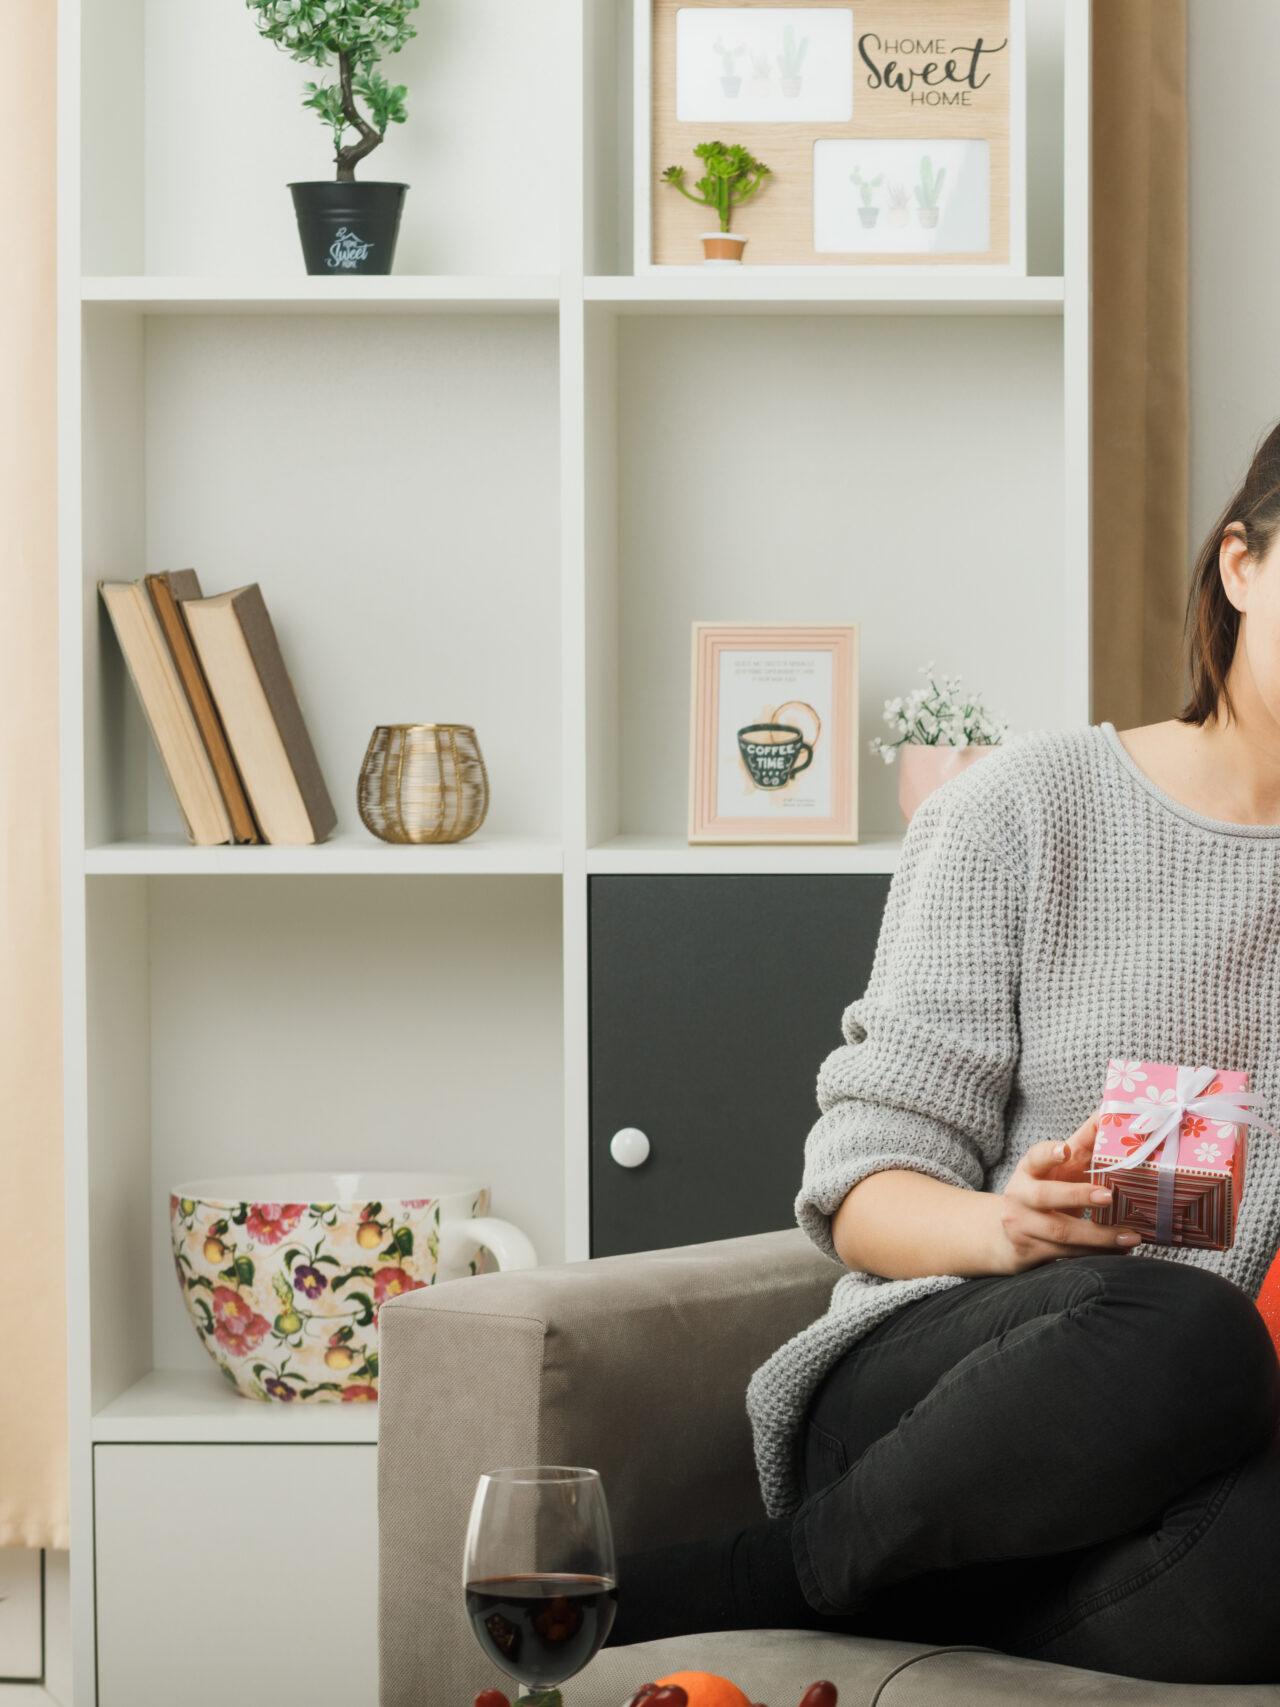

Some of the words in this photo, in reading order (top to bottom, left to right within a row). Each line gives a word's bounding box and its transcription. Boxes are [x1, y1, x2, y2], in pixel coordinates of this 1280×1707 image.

[884, 38, 947, 55] HOME
[857, 33, 1008, 93] Sweet
[910, 90, 973, 107] HOME
[746, 744, 796, 756] COFFEE
[756, 757, 785, 770] TIME
